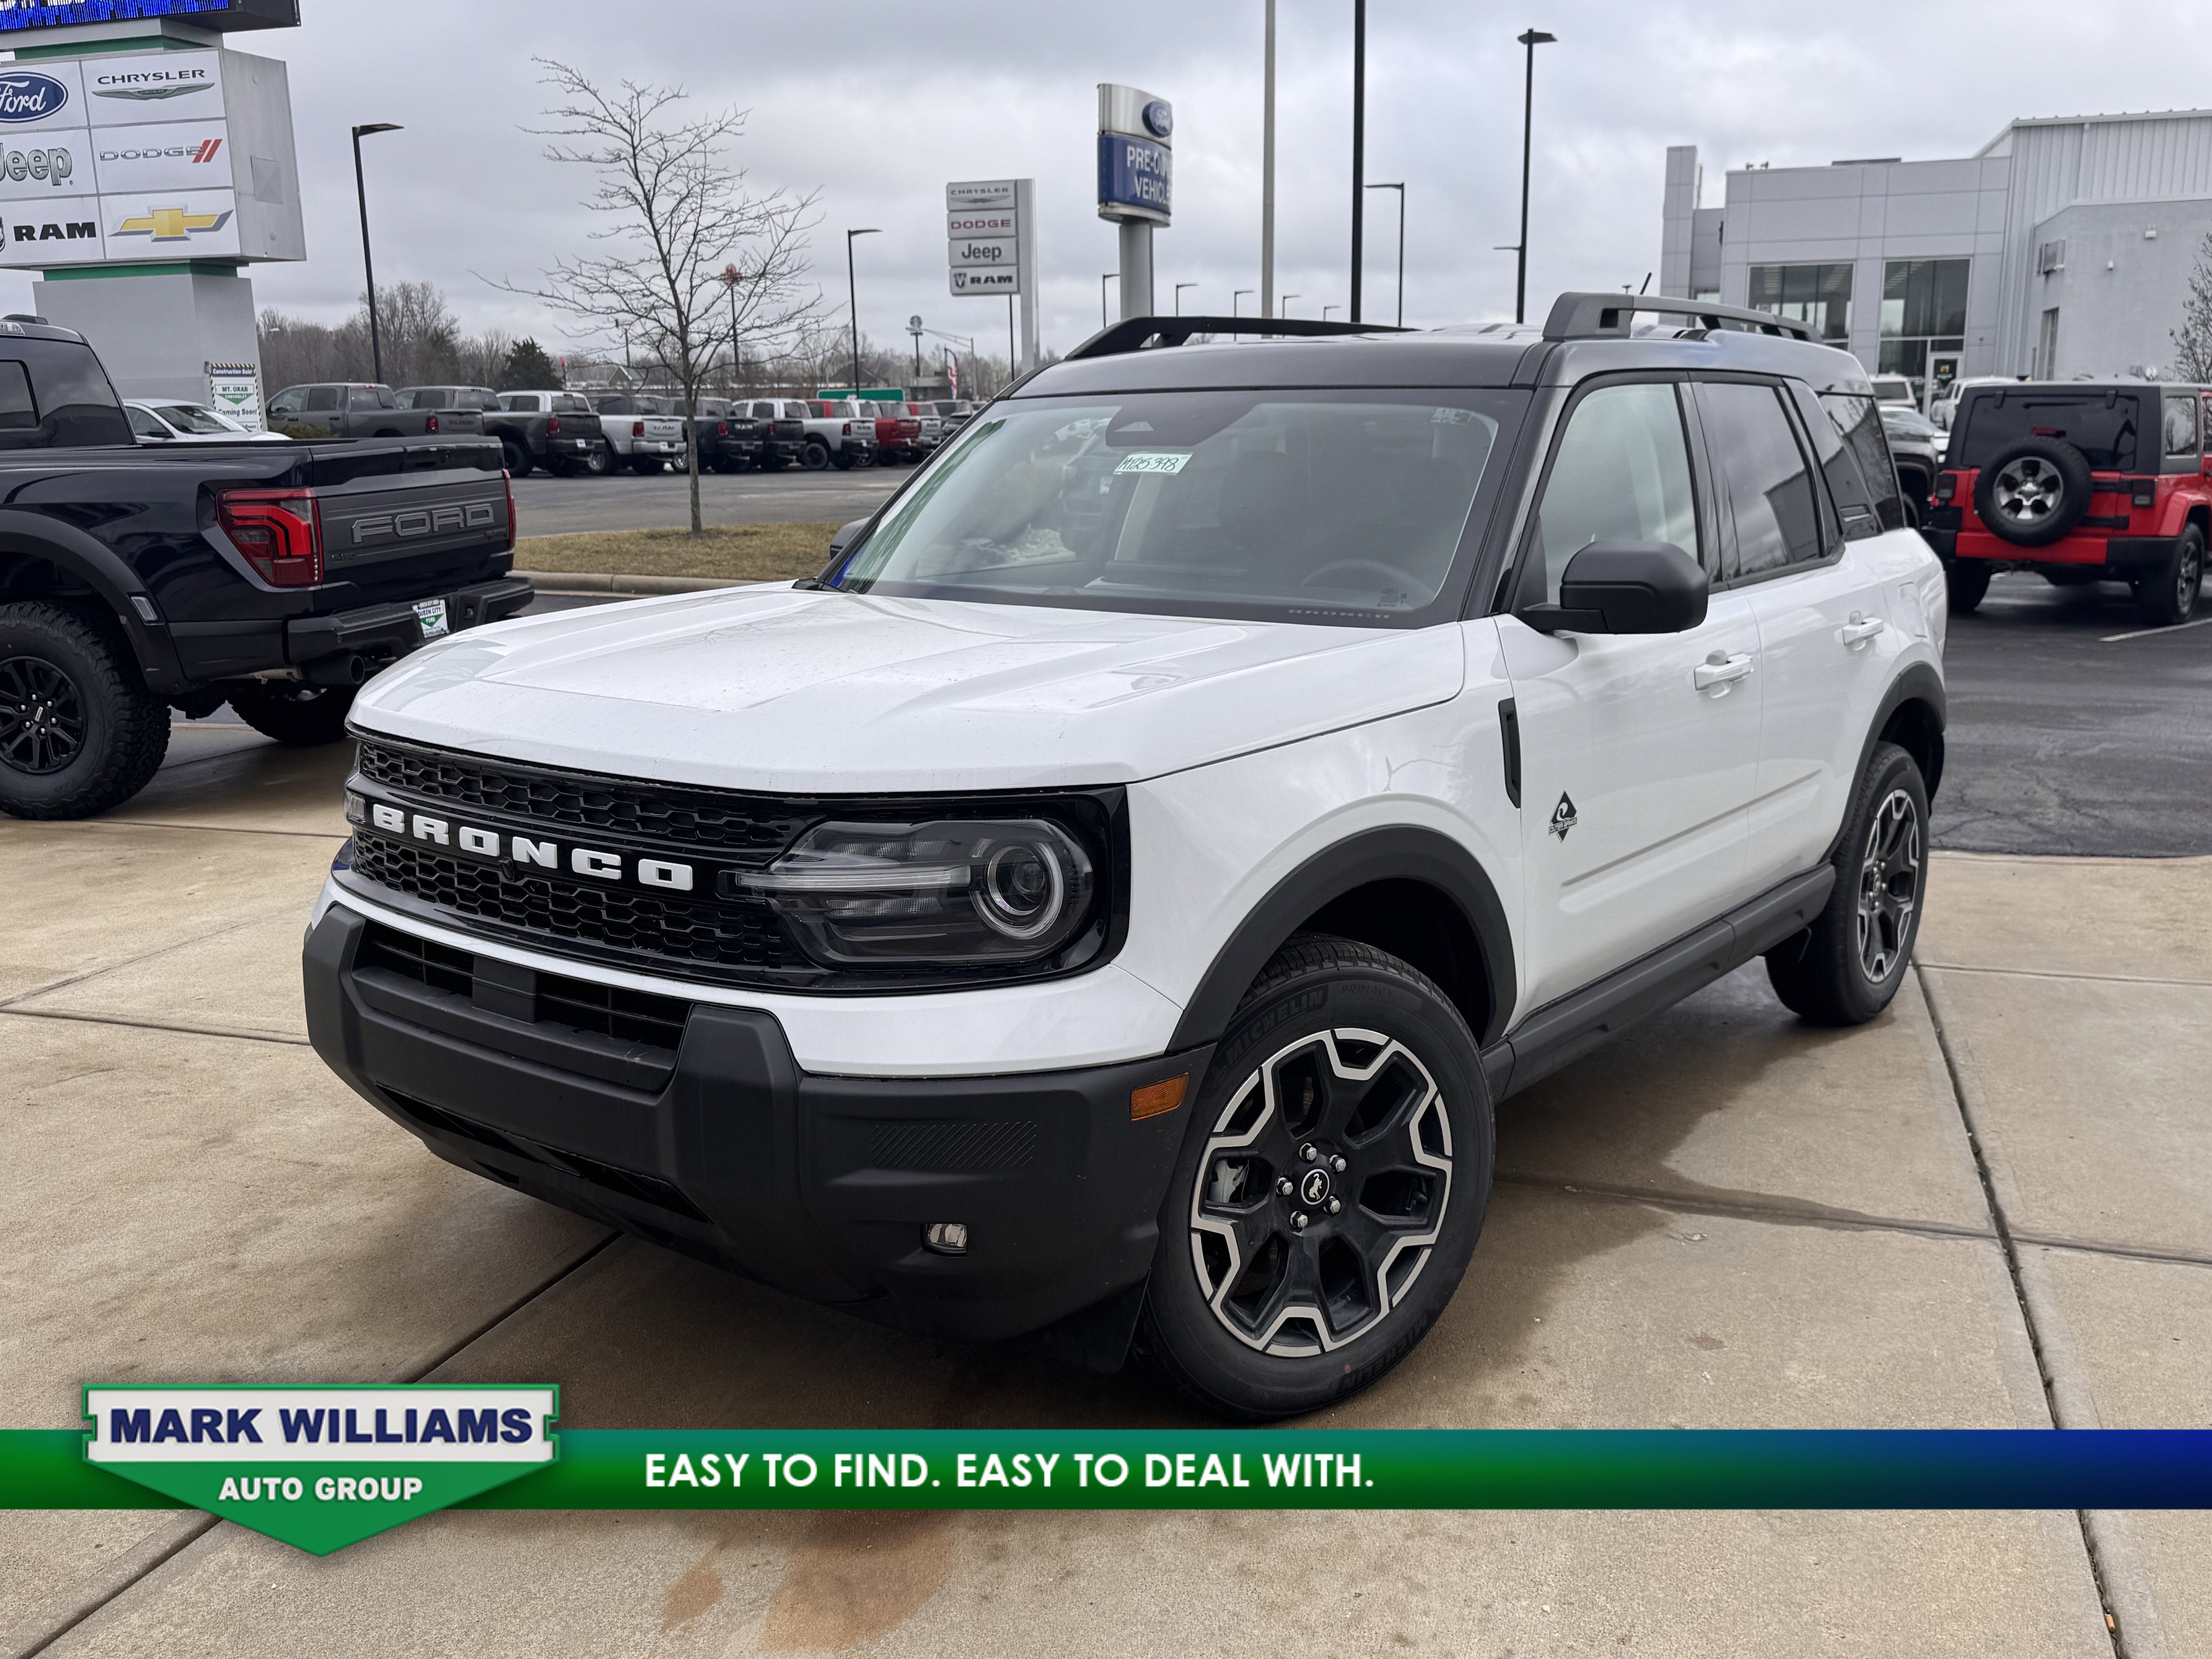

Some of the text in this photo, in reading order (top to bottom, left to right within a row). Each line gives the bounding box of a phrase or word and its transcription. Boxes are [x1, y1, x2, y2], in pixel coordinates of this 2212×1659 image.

[98, 69, 205, 84] CHRYSLER
[100, 146, 205, 161] DODGE
[0, 143, 73, 186] eep
[14, 222, 96, 242] RAM
[951, 219, 1011, 230] DODGE
[961, 243, 1002, 261] Jeep
[970, 276, 1013, 285] RAM
[352, 503, 494, 543] FORD
[373, 804, 693, 891] BRONCO
[1225, 989, 1324, 1066] MICHELIN
